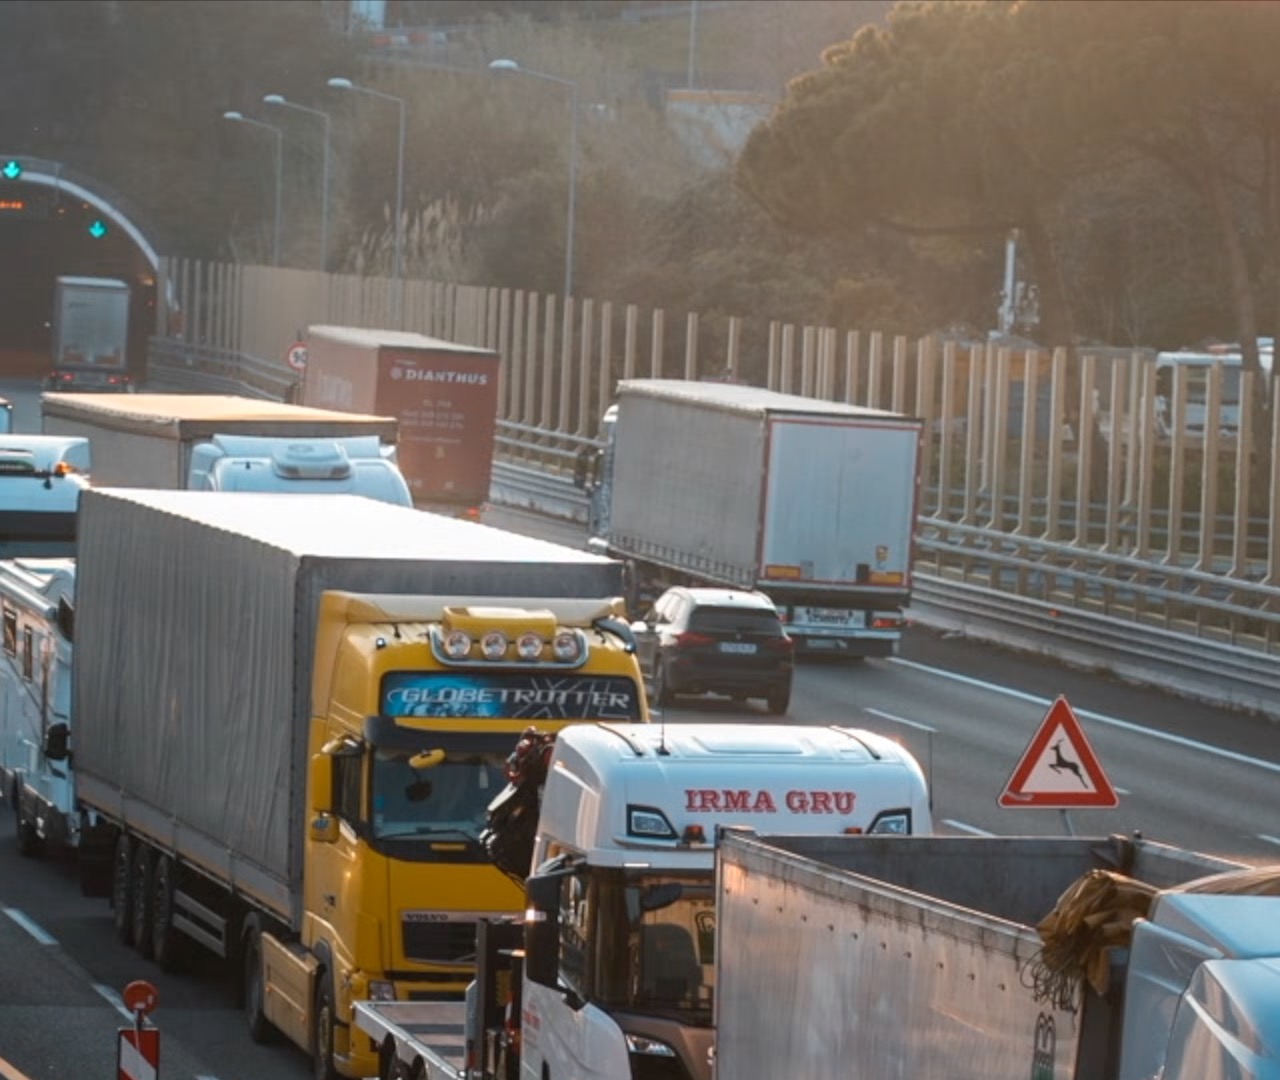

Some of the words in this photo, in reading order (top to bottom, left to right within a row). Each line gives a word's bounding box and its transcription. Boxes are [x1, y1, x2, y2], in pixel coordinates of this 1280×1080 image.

[405, 369, 488, 385] DIANTHUS
[400, 687, 630, 709] GLOBETROTTER
[685, 789, 776, 812] IRMA
[785, 790, 856, 815] GRU
